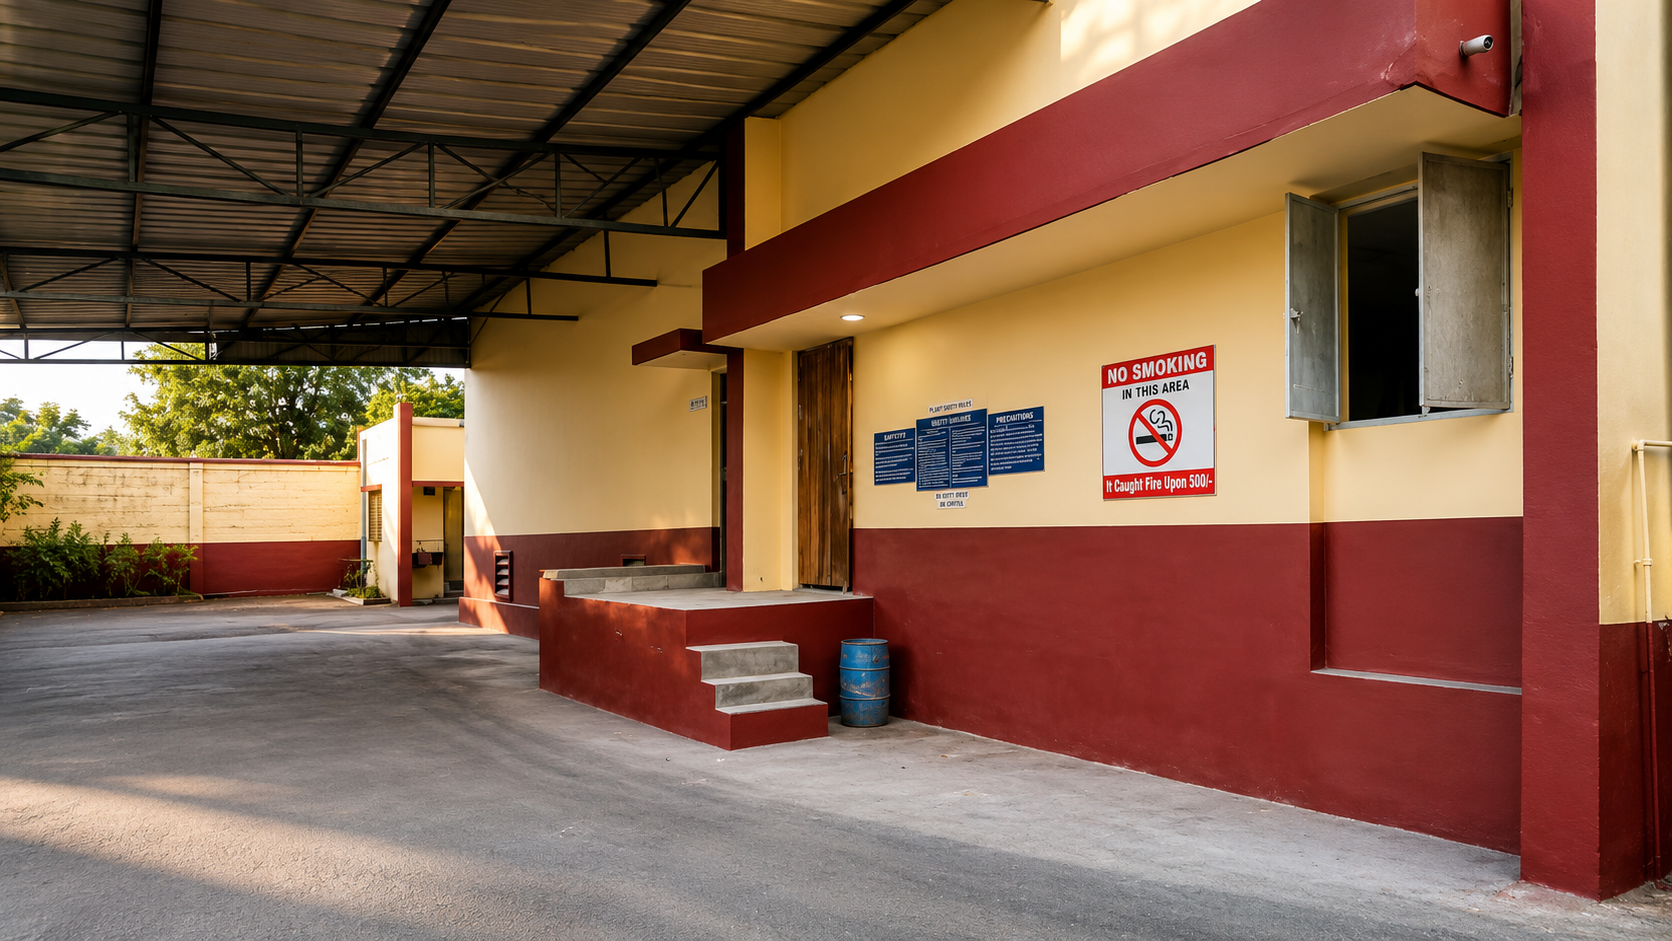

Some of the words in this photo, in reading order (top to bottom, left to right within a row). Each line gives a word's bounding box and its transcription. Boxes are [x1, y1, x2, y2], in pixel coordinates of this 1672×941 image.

[1107, 367, 1128, 384] NO
[1132, 351, 1207, 380] SMOKING
[1122, 388, 1132, 400] IN
[1136, 384, 1158, 397] THIS
[1162, 379, 1190, 394] AREA
[1106, 480, 1112, 493] It
[1114, 478, 1143, 494] Caught
[1145, 476, 1162, 491] Fire
[1164, 475, 1187, 493] Upon
[1189, 473, 1213, 488] 500/-
